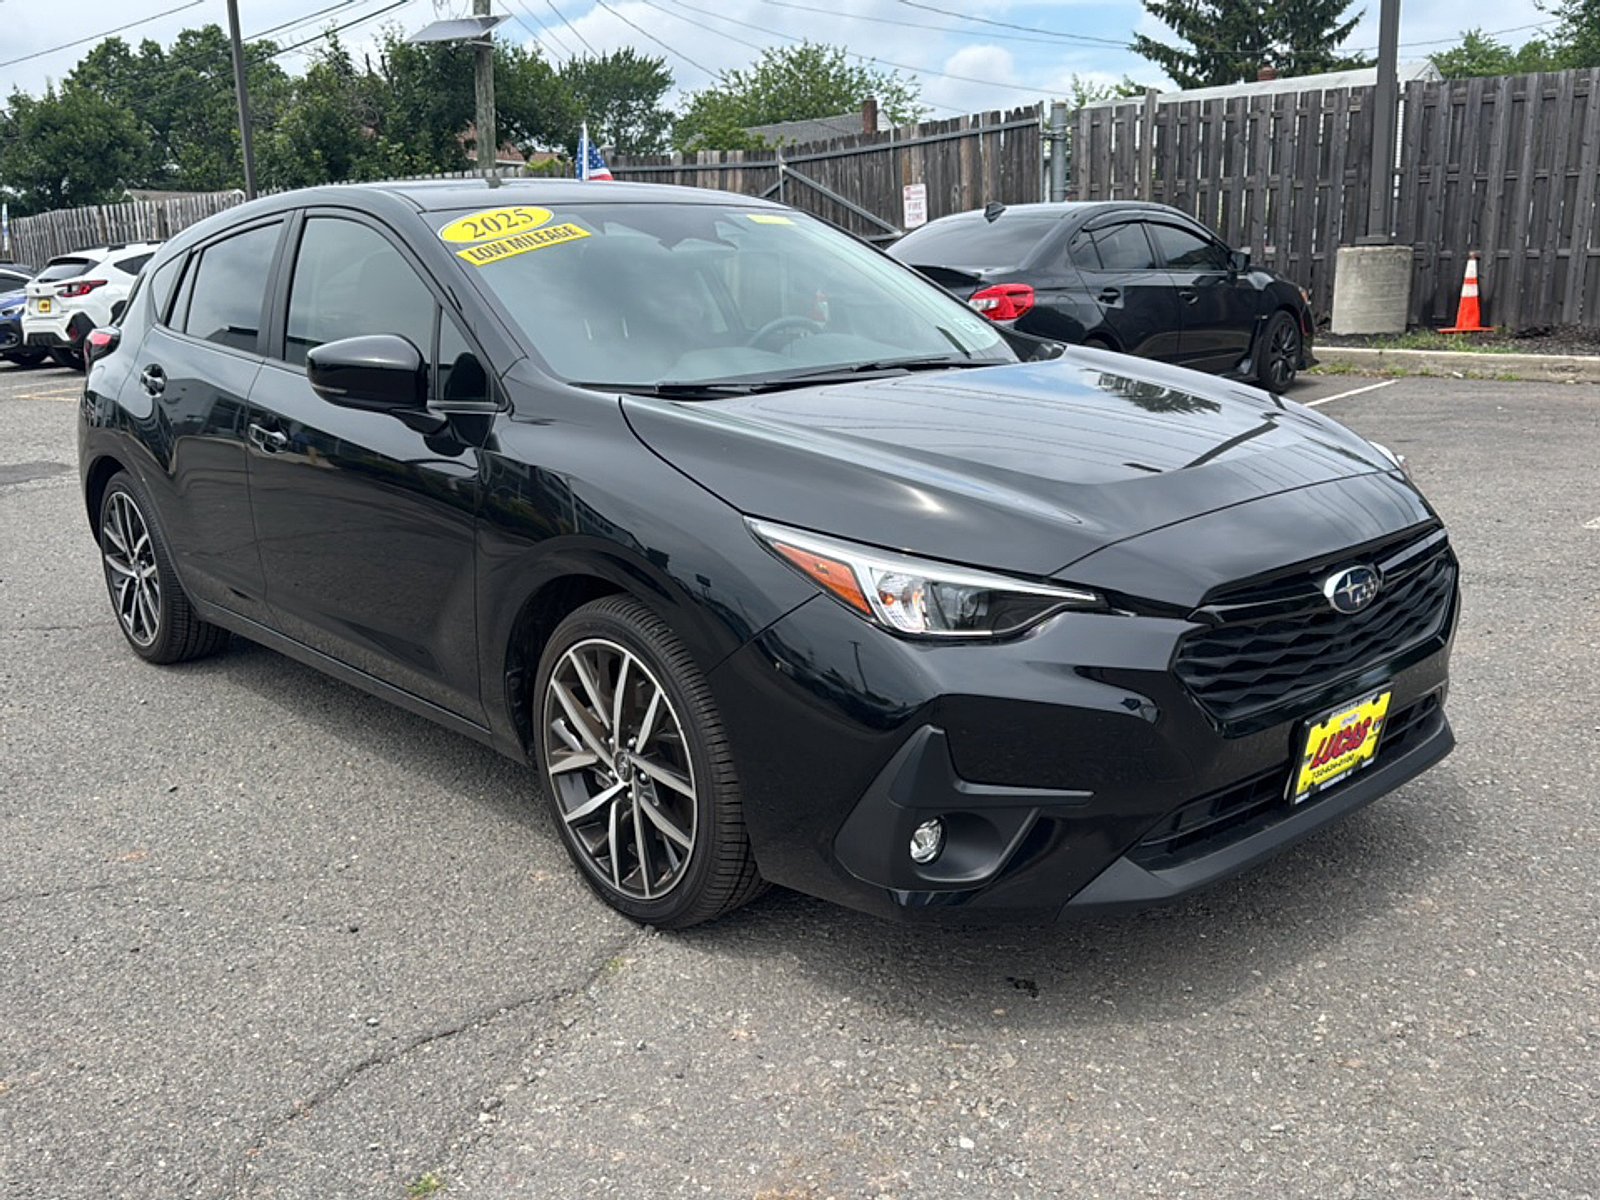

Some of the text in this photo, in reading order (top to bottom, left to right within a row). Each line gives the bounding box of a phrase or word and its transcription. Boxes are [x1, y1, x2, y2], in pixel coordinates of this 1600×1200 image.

[461, 208, 534, 240] 2025
[468, 225, 578, 261] LOW MILEAGE
[1309, 716, 1372, 770] LUCAS
